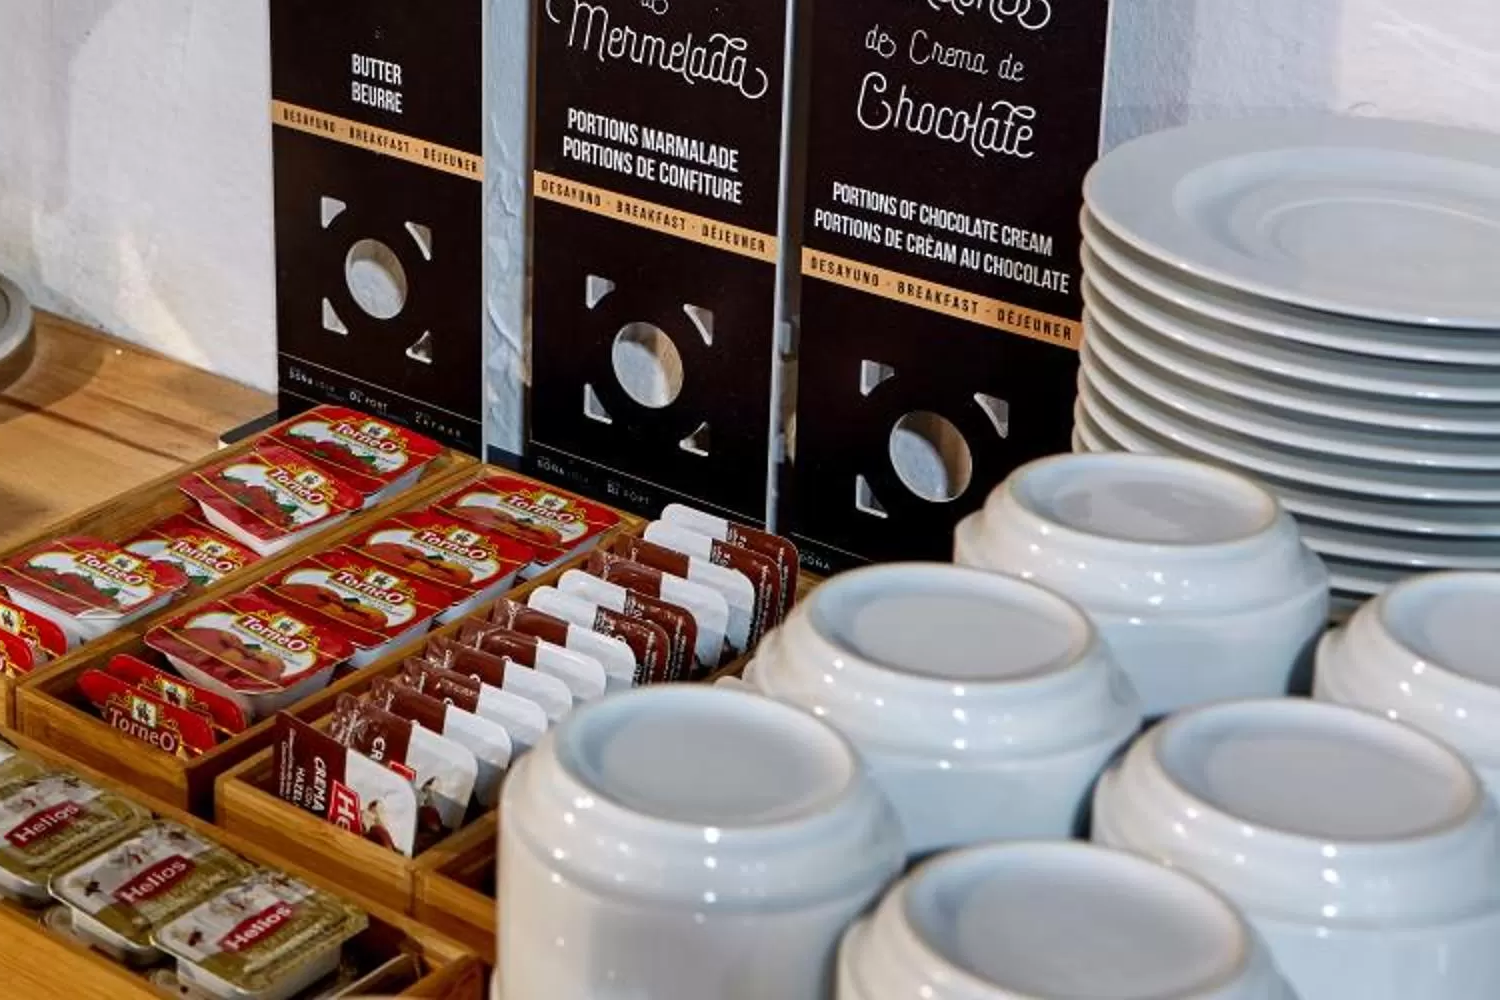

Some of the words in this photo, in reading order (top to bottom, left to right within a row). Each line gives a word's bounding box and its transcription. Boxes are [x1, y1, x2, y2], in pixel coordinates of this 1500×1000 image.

[351, 52, 403, 85] BUTTER
[865, 23, 897, 59] de
[909, 29, 990, 75] Crema
[998, 52, 1026, 83] de
[351, 81, 404, 114] BEURRE
[856, 71, 1037, 159] Chocolate
[350, 124, 411, 153] BREAKFAST
[567, 106, 639, 147] PORTIONS
[640, 126, 740, 173] MARMALADE
[562, 135, 634, 176] PORTIONS
[635, 154, 656, 182] DE
[658, 161, 744, 205] CONFITURE
[541, 178, 602, 207] DESAYUNO
[616, 201, 687, 231] BREAKFAST
[832, 180, 897, 217] PORTIONS
[899, 199, 918, 221] OF
[918, 204, 999, 244] CHOCOLATE
[1001, 224, 1054, 257] CREAM
[814, 207, 882, 244] PORTIONS
[884, 229, 904, 250] DE
[959, 249, 981, 272] AU
[982, 255, 1070, 295] CHOCOLATE
[809, 256, 880, 287] DESAYUNO
[897, 281, 979, 315] BREAKFAST
[12, 803, 82, 844] Helios
[118, 858, 189, 905] Helios
[223, 902, 293, 951] Helios
